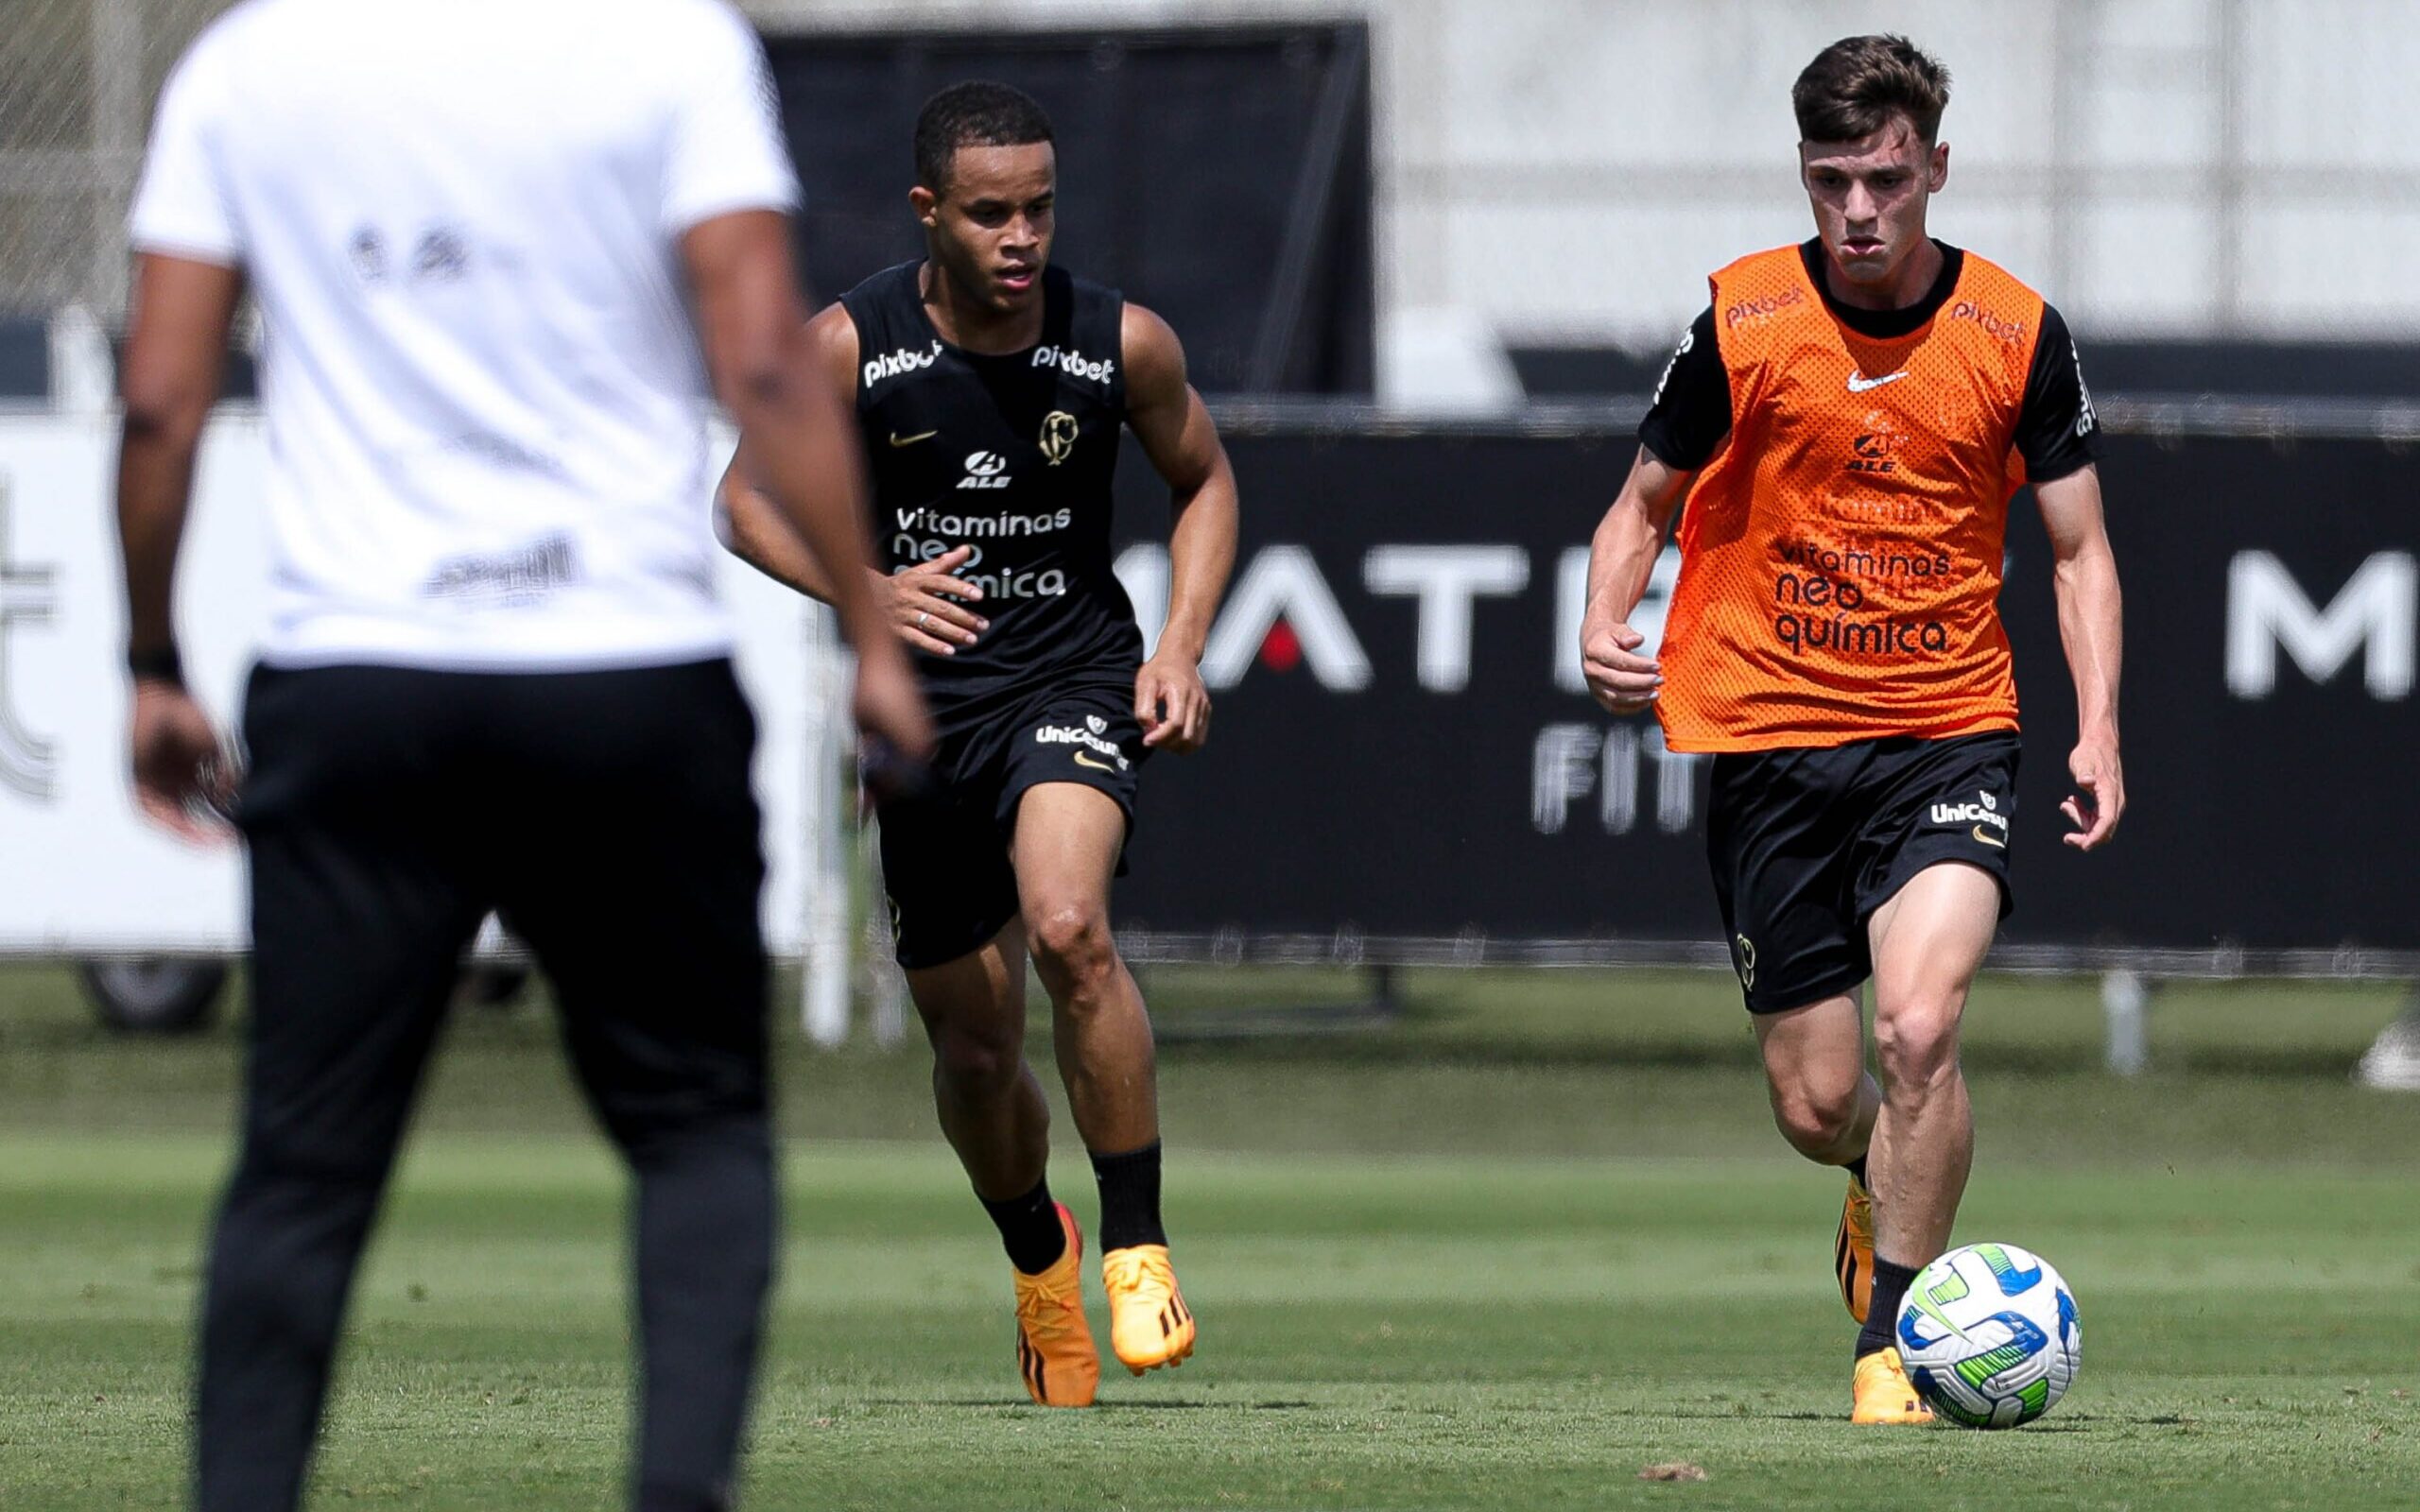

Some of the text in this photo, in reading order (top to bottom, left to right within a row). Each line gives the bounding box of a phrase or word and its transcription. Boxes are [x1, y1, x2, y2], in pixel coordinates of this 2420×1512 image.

[1725, 286, 1805, 329] pixbet
[1951, 300, 2027, 347] pixbet
[1031, 344, 1115, 385] pixbet
[956, 476, 1012, 490] ALE
[1844, 459, 1896, 473] ALE
[896, 507, 1072, 538] vitaminas
[1775, 541, 1951, 576] vitaminas
[893, 564, 1067, 602] mica
[1775, 573, 1864, 610] neo
[1774, 611, 1947, 656] química
